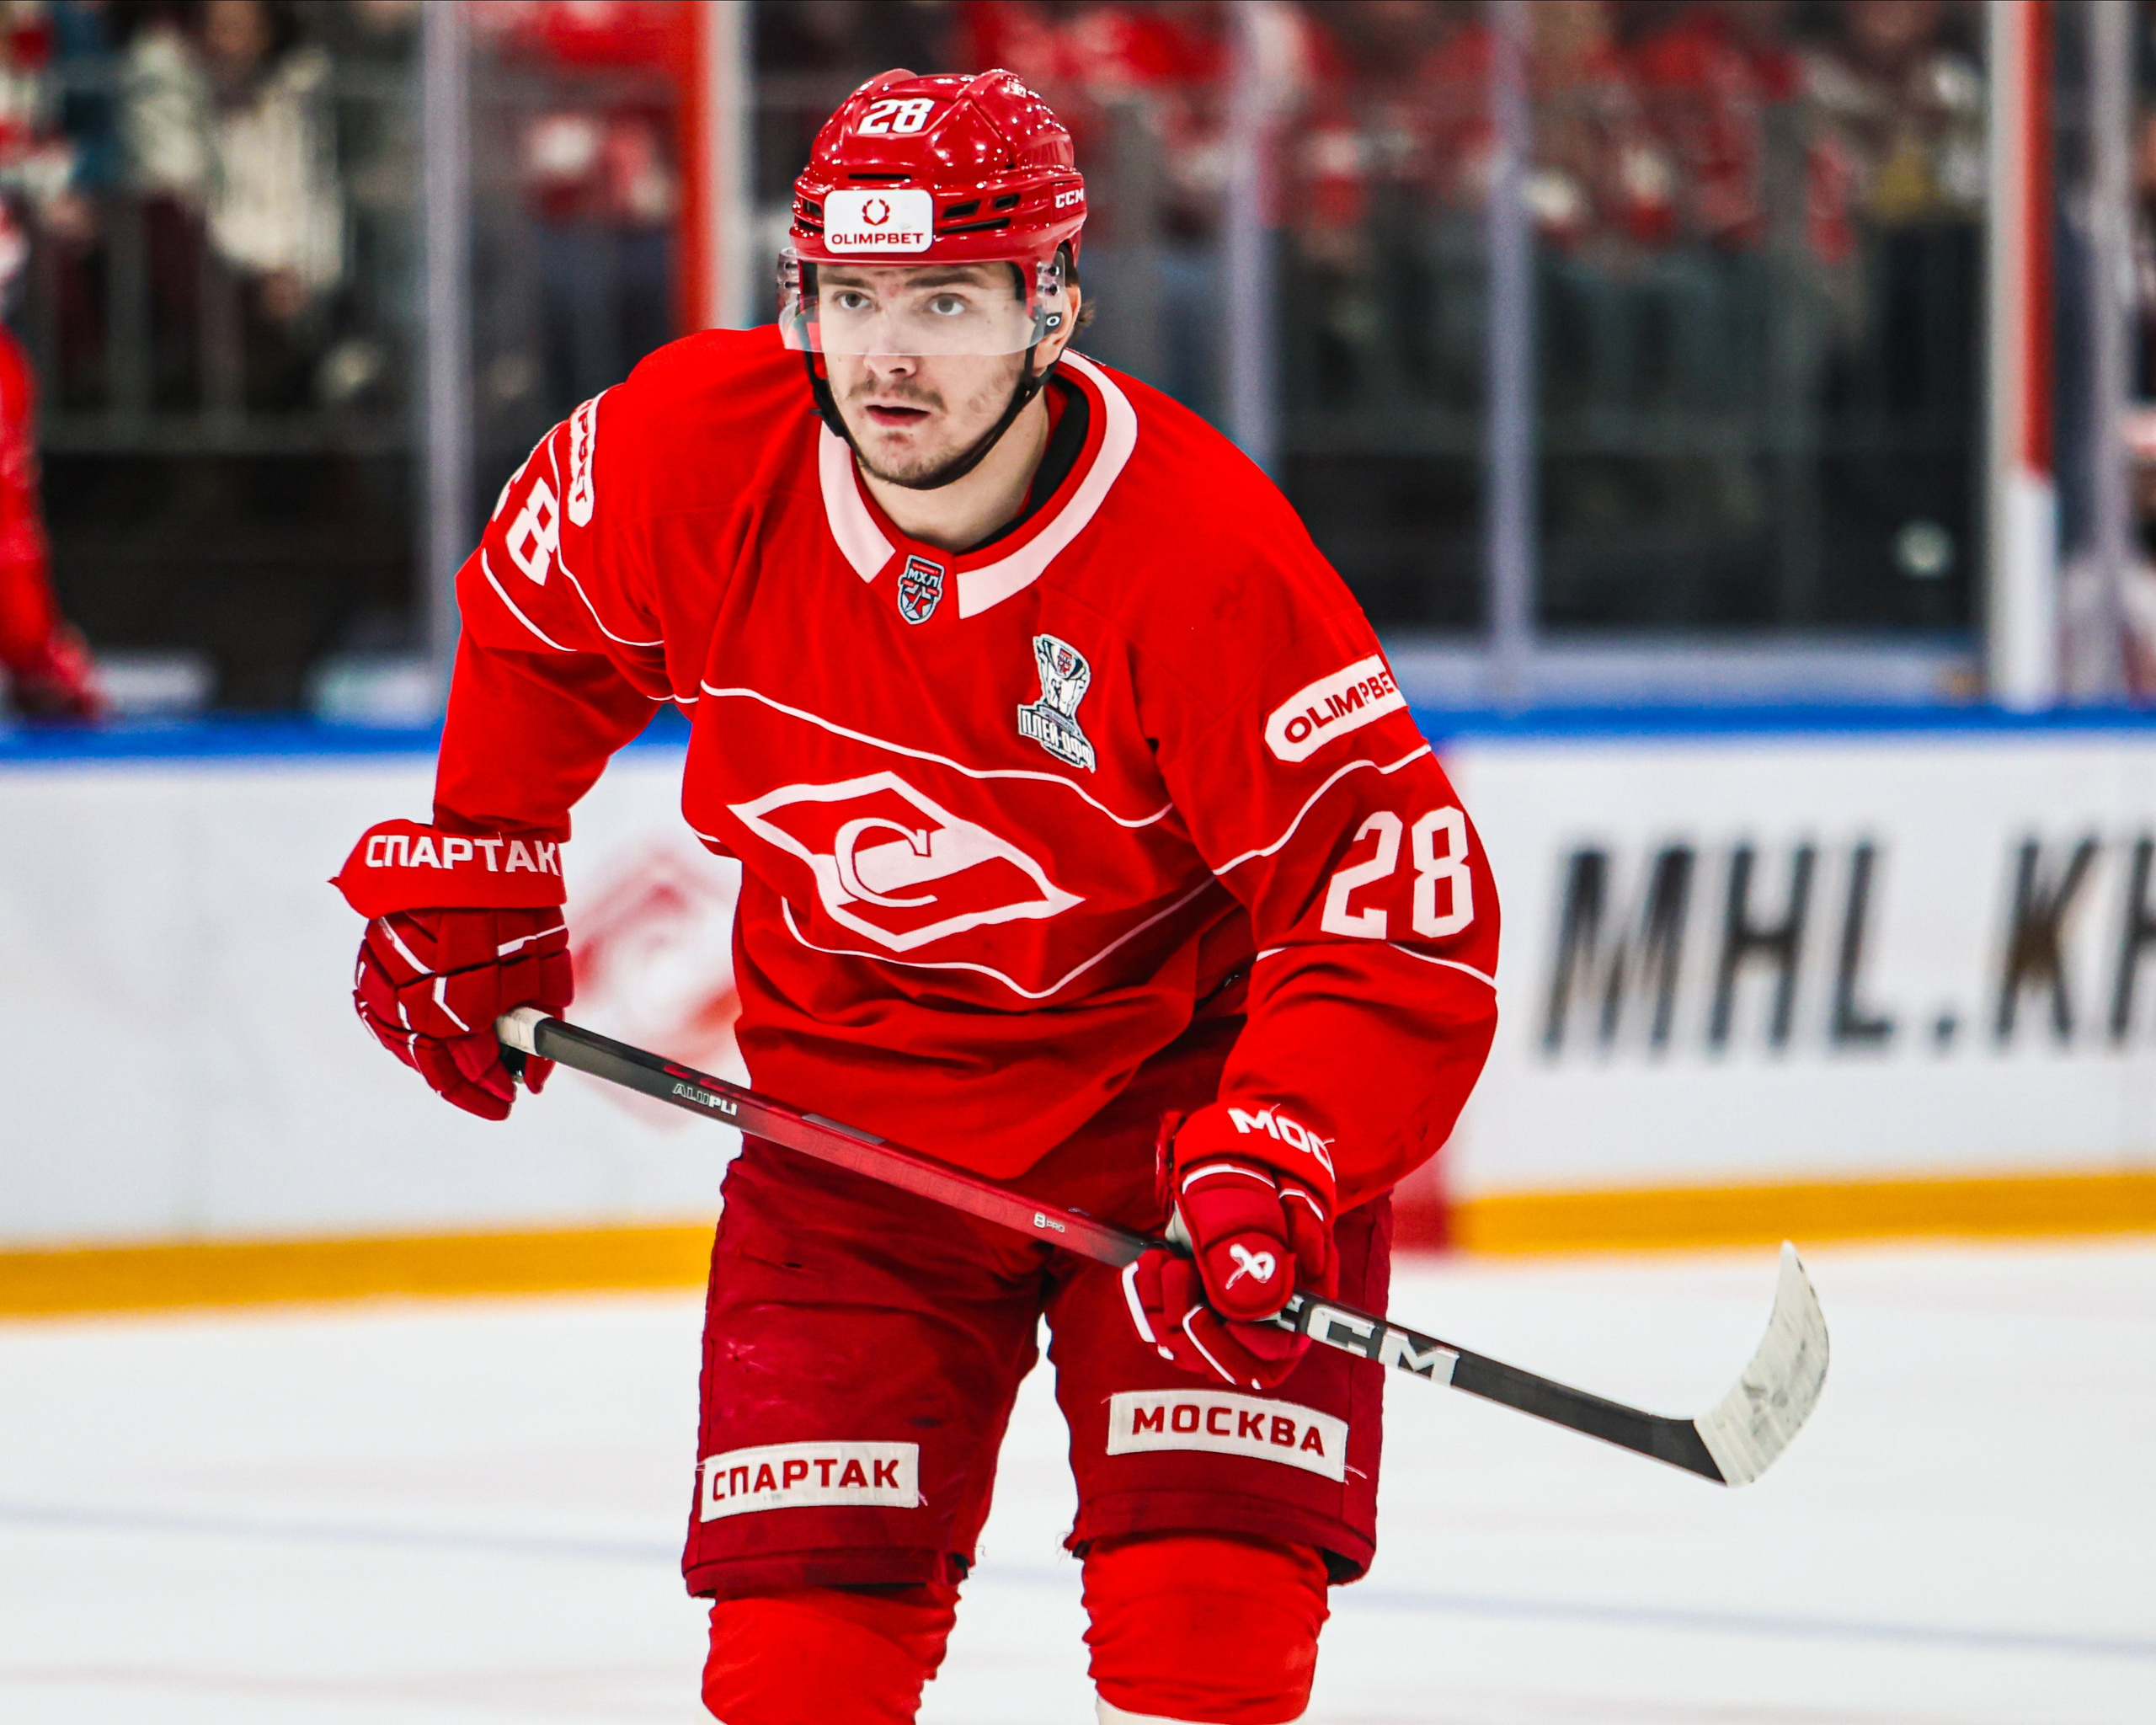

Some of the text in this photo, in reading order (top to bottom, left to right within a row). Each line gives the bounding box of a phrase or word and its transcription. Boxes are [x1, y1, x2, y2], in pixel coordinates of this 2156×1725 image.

[857, 98, 935, 134] 28
[1055, 187, 1085, 209] CCM
[831, 232, 925, 245] OLIMPBET
[907, 567, 940, 589] МХЛ
[365, 833, 562, 877] СПАРТАК
[1321, 805, 1474, 939] 28
[1133, 1404, 1326, 1457] МОСКВА
[712, 1459, 899, 1502] СПАРТАК
